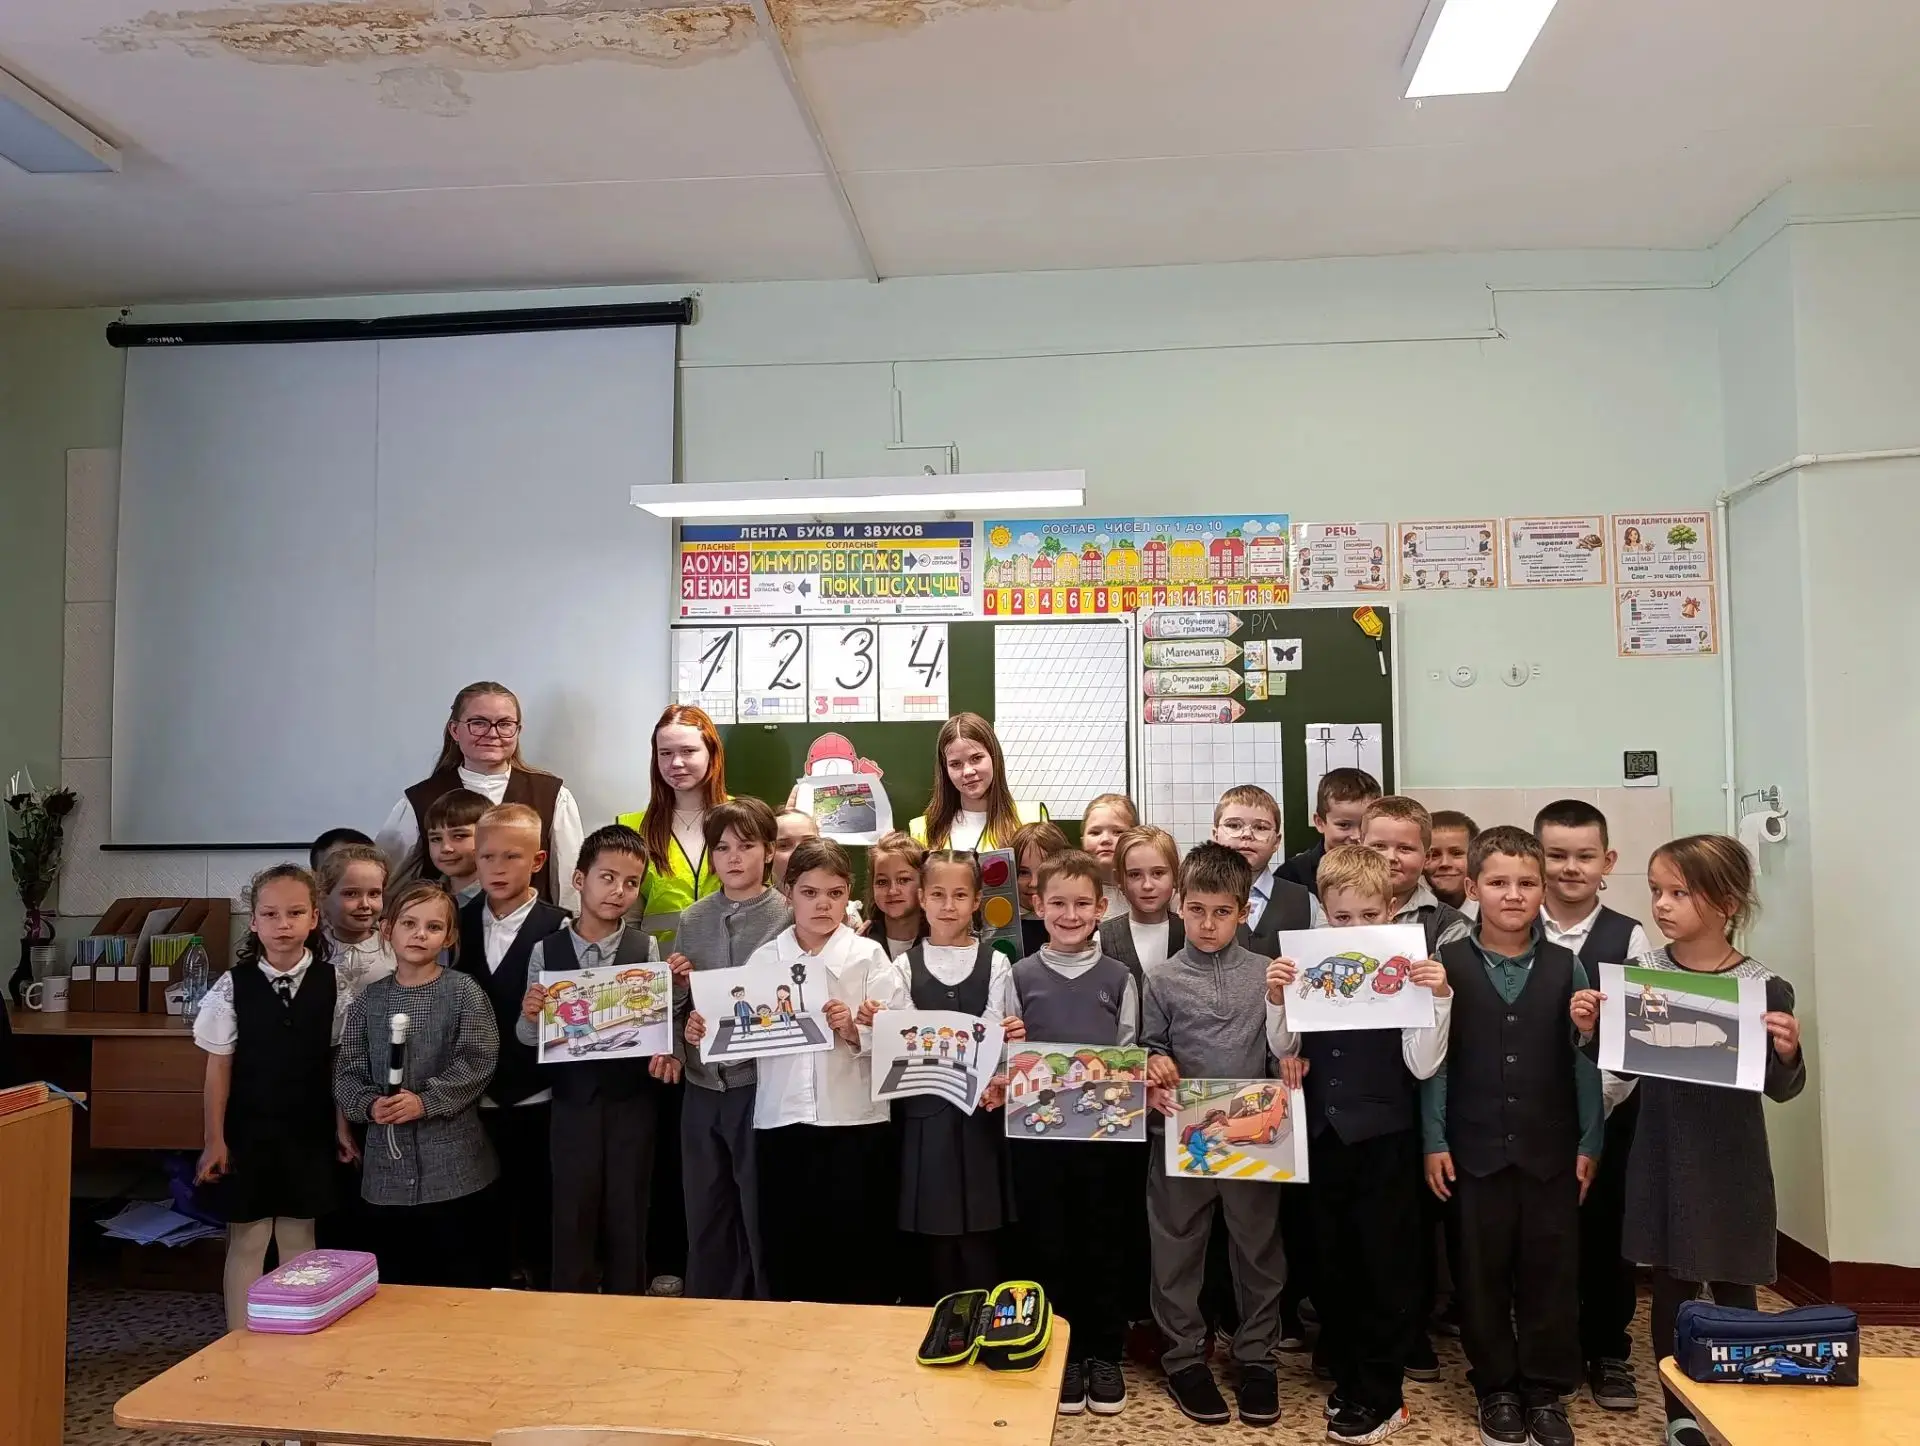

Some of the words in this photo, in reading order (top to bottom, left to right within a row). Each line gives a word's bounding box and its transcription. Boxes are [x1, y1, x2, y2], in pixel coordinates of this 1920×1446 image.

[740, 527, 788, 538] ЛЕНТА
[797, 526, 835, 538] БУКВ
[844, 526, 855, 537] И
[864, 525, 923, 537] ЗВУКОВ
[1042, 524, 1096, 534] СОСТАВ
[1105, 522, 1150, 532] ЧИСЕЛ
[1155, 522, 1171, 532] от
[1175, 521, 1181, 531] 1
[1185, 521, 1203, 532] до
[1208, 520, 1223, 531] 10
[1325, 527, 1357, 536] РЕЧЬ
[696, 543, 736, 551] ГЛАСНЫЕ
[825, 541, 878, 549] СОГЛАСНЫЕ
[986, 593, 994, 608] 0
[1001, 592, 1008, 609] 1
[1014, 592, 1023, 609] 2
[1027, 592, 1036, 609] 3
[1041, 591, 1050, 608] 4
[1055, 591, 1064, 608] 5
[1069, 591, 1078, 608] 6
[1082, 591, 1092, 608] 7
[1097, 591, 1106, 607] 8
[1111, 591, 1120, 607] 9
[1123, 591, 1136, 607] 10
[1139, 592, 1149, 606] 11
[1153, 590, 1166, 606] 12
[1168, 590, 1181, 606] 13
[1182, 590, 1196, 606] 14
[1199, 590, 1212, 606] 15
[1214, 589, 1227, 605] 16
[1229, 590, 1242, 605] 17
[1244, 588, 1258, 604] 18
[1260, 589, 1273, 605] 19
[1274, 588, 1288, 604] 20
[1650, 589, 1681, 599] Звуки
[1179, 617, 1215, 626] Обучение
[907, 626, 943, 688] 4
[1165, 647, 1220, 657] Математика
[700, 630, 733, 692] 1
[770, 628, 802, 690] 2
[835, 627, 874, 690] 3
[1172, 674, 1219, 684] Окружающий
[814, 696, 829, 715] 3
[1177, 702, 1217, 711] Внеурочная
